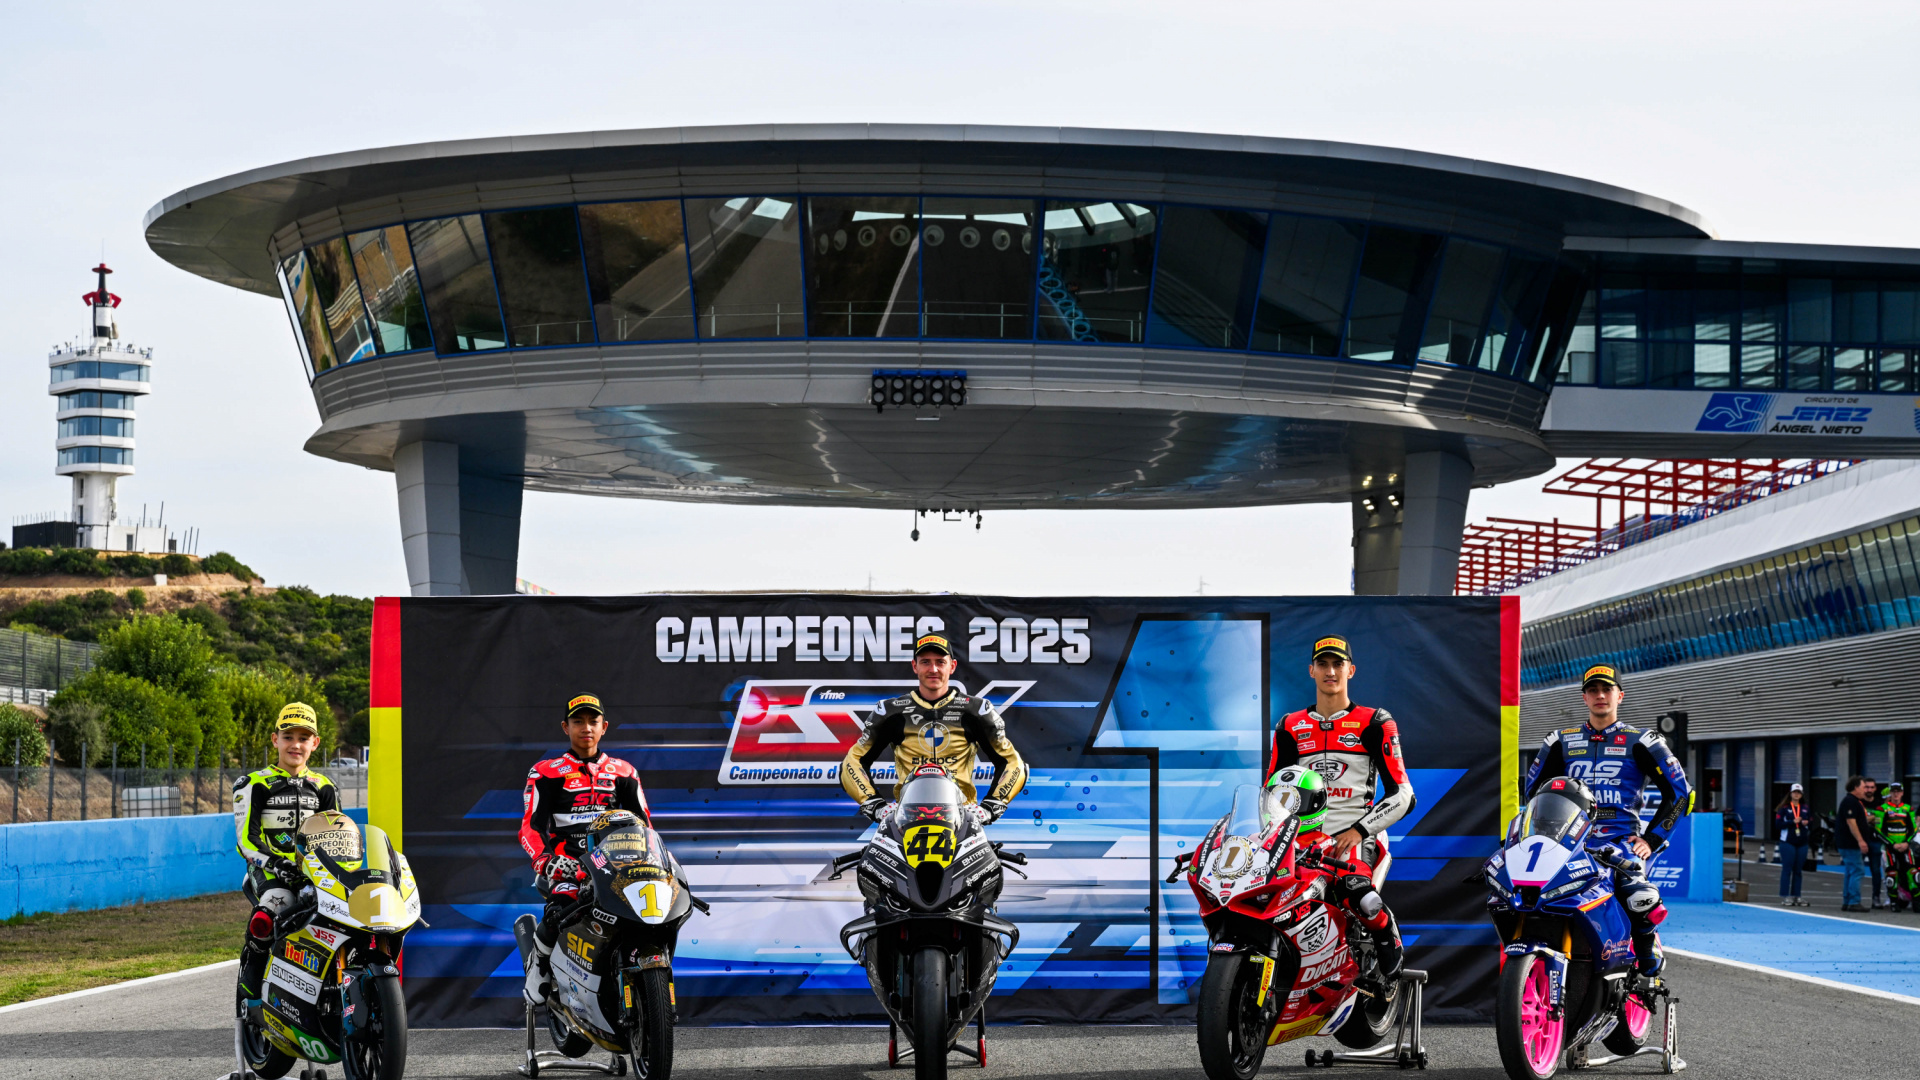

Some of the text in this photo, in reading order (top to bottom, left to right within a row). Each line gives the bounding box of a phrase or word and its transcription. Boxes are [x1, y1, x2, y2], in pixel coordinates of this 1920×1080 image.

[1804, 396, 1845, 404] CIRCUITO
[1775, 406, 1873, 422] JEREZ
[1768, 421, 1864, 435] ÁNGEL NIETO
[918, 636, 946, 646] PIRELLI
[968, 616, 1091, 664] 2025
[1316, 638, 1346, 649] PIRELLI
[1585, 666, 1613, 680] PIRELLI
[819, 689, 846, 700] rfme
[282, 713, 315, 724] DUNLOP
[729, 765, 823, 781] Campeonato
[827, 765, 838, 780] d
[572, 792, 614, 807] SIC
[1327, 786, 1353, 799] CATI
[1594, 789, 1622, 805] AHA
[570, 804, 607, 812] RACING
[1366, 813, 1384, 825] SPEED
[305, 831, 340, 843] MARCOS
[305, 840, 345, 851] CAMPEÓN
[604, 840, 641, 851] CHAMPION
[906, 826, 955, 862] 44
[1269, 818, 1298, 869] SPEED RACING
[868, 847, 899, 868] BHTRANS
[961, 846, 991, 867] BHTRANS
[1199, 839, 1211, 867] RACING
[1220, 846, 1241, 870] 1
[1525, 841, 1544, 873] 1
[1568, 867, 1591, 880] YAMAHA
[369, 886, 393, 924] 1
[639, 883, 664, 918] 1
[1295, 900, 1312, 923] YSS
[311, 927, 337, 944] YSS
[566, 931, 596, 964] SIC
[284, 940, 320, 974] italkit
[567, 948, 594, 972] RACING
[1300, 947, 1349, 983] DUCATI
[271, 963, 317, 997] SNIPERS
[1261, 960, 1273, 992] PIRELLI
[280, 998, 300, 1016] GRUPO
[298, 1036, 330, 1061] 80
